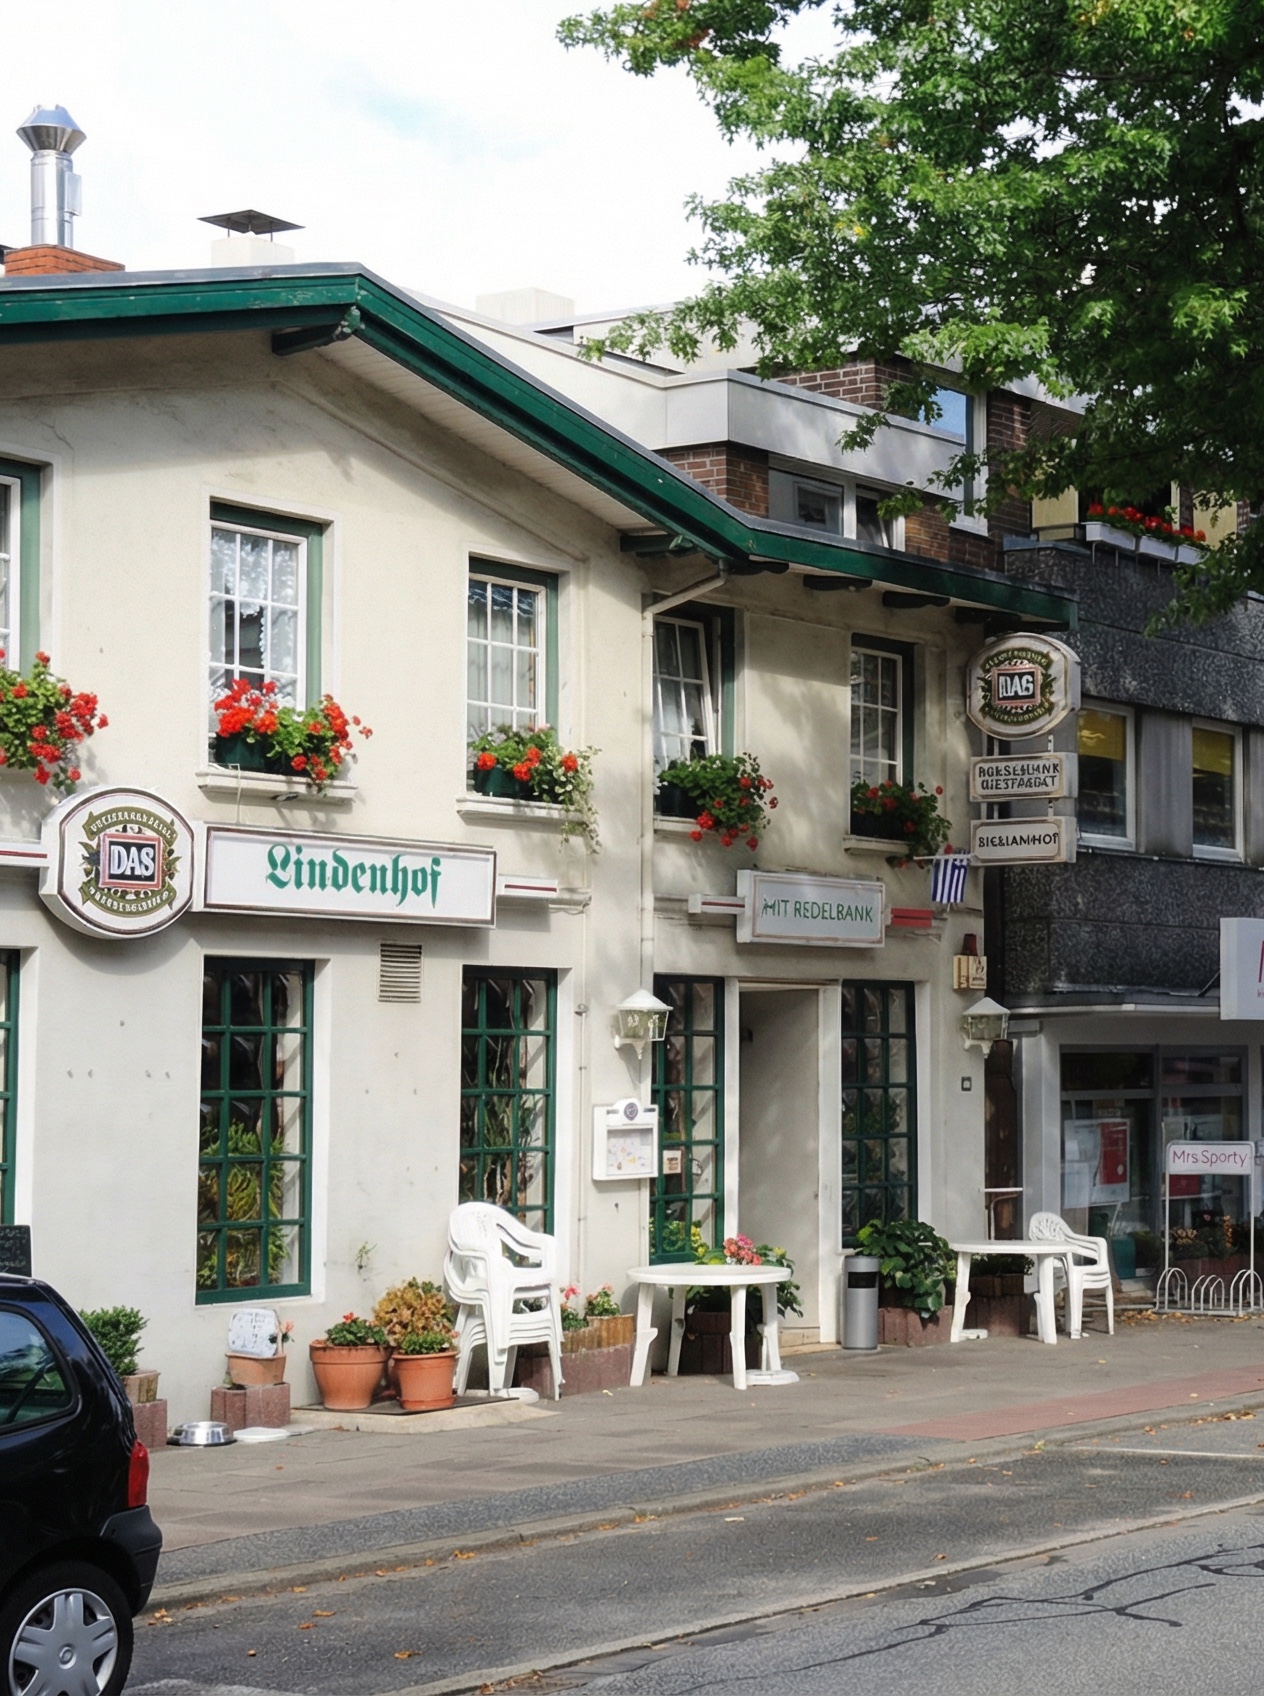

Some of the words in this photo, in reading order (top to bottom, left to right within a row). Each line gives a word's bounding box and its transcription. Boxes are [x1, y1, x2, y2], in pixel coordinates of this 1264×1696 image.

[109, 845, 155, 877] DAS
[266, 843, 442, 909] Lindenhof
[1172, 1150, 1199, 1164] Mrs
[1200, 1149, 1248, 1167] Sporty
